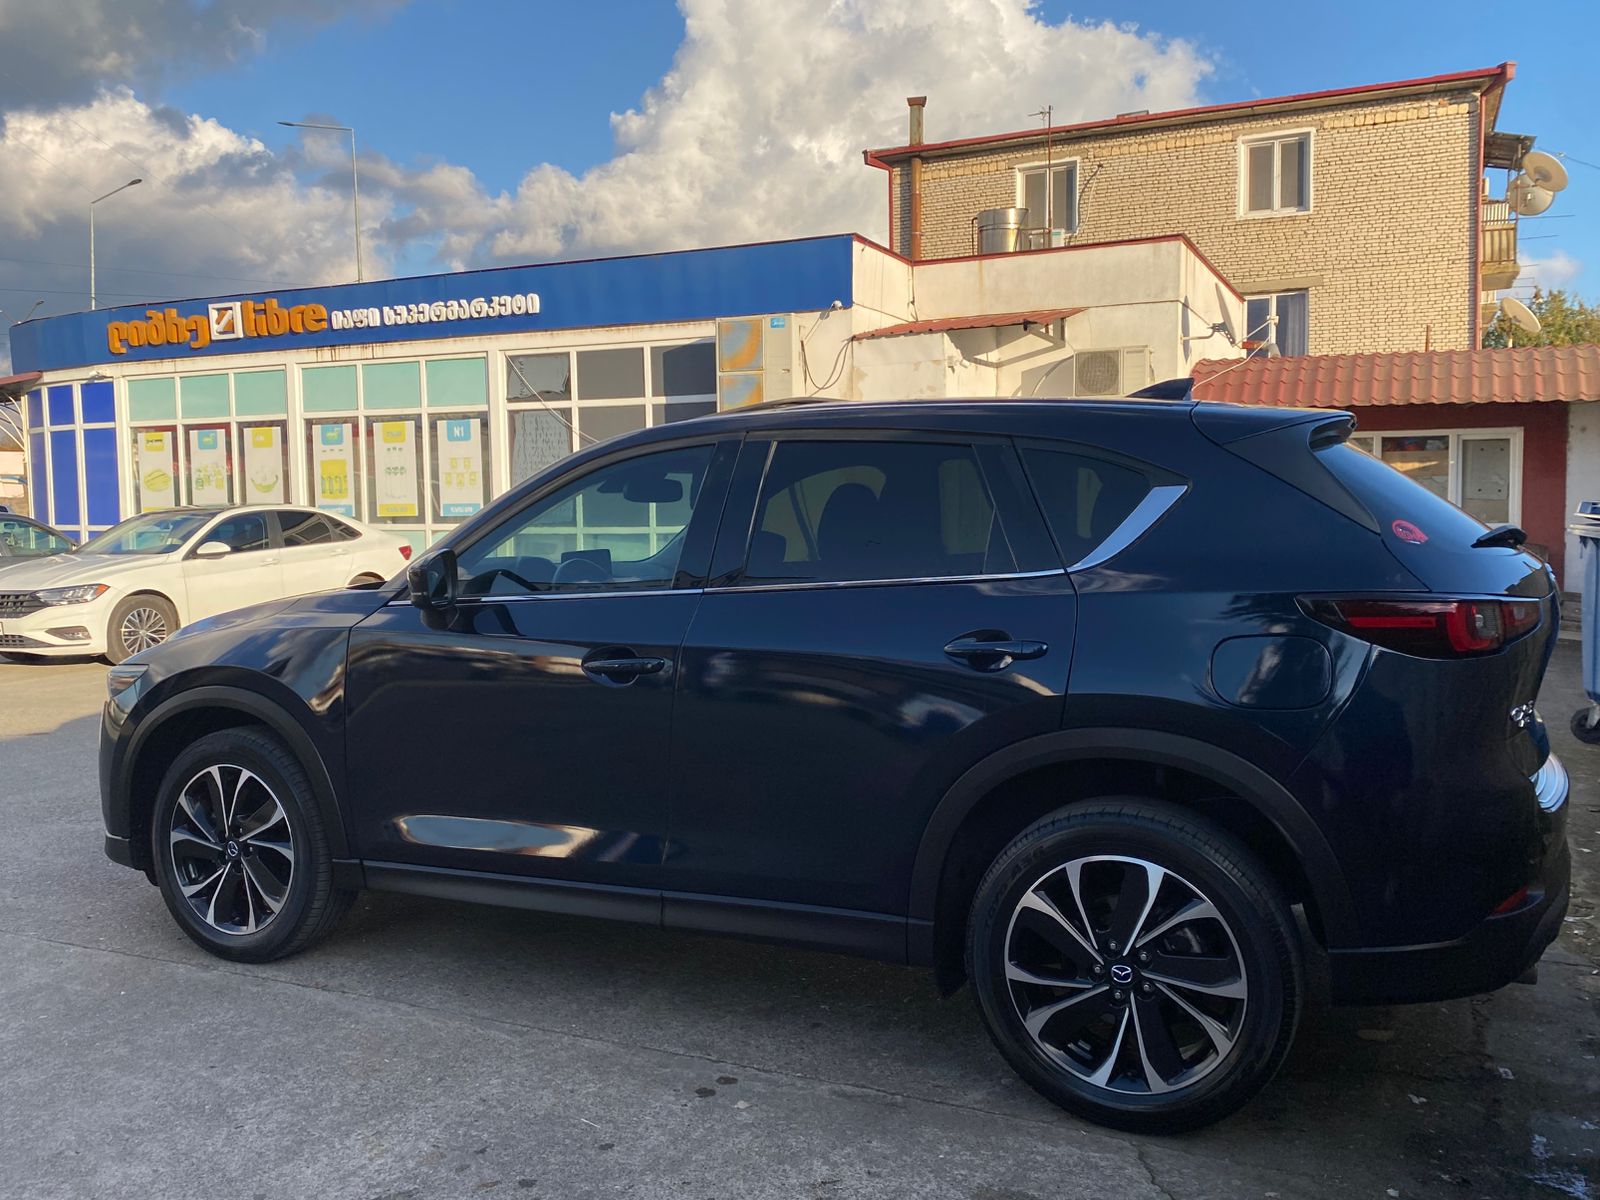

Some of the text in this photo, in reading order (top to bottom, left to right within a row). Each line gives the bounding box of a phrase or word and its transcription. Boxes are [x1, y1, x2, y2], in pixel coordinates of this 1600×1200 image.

[107, 308, 210, 354] ლიბრე
[241, 298, 328, 337] libre
[331, 293, 540, 330] იაფი სუპერმარკეტი
